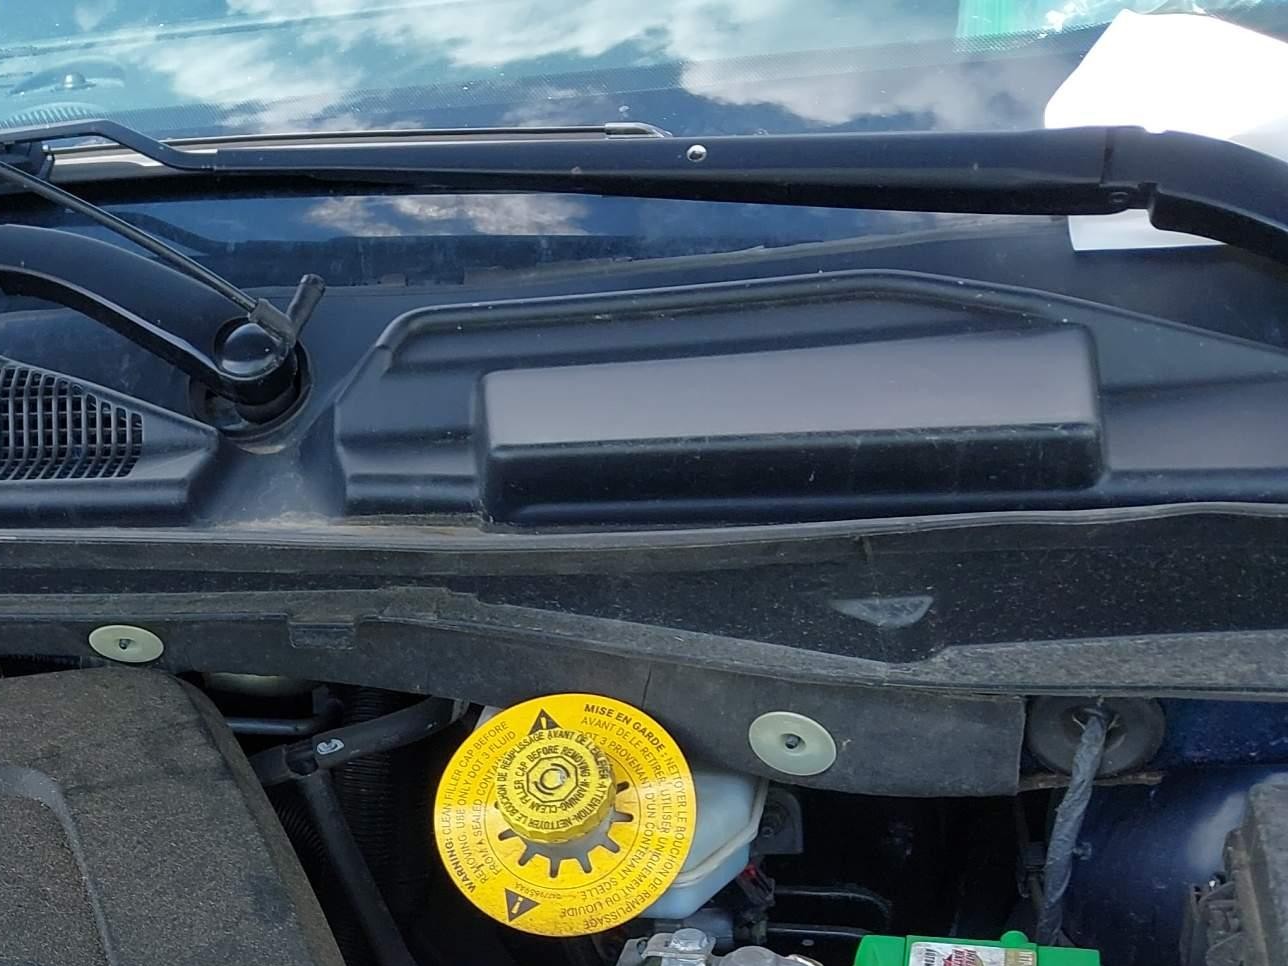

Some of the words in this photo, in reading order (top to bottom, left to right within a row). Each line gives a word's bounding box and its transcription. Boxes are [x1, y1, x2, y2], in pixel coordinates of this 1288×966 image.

[584, 703, 614, 718] MISE
[615, 712, 632, 726] EN
[472, 720, 508, 750] BEFORE
[547, 731, 575, 740] AVANT
[581, 715, 615, 732] AVANT
[615, 727, 629, 739] DE
[629, 736, 642, 748] LE
[631, 721, 665, 752] GARDE
[458, 748, 476, 768] CAP
[500, 732, 544, 770] REMPLISSAGE
[527, 745, 559, 762] BEFORE
[606, 740, 652, 788] PROVENANT
[457, 779, 472, 805] ONLY
[466, 758, 483, 778] DOT
[481, 751, 490, 759] 3
[487, 730, 516, 753] FLUID
[498, 772, 507, 781] DE
[515, 761, 528, 776] CAP
[445, 768, 463, 800] FILLER
[514, 780, 531, 804] FILLER
[442, 803, 452, 834] CLEAN
[471, 798, 483, 836] SEALED
[677, 811, 686, 821] LE
[443, 837, 478, 892] WARNING:
[657, 826, 685, 877] BOUCHON
[648, 877, 664, 891] DE
[583, 889, 652, 928] REMPLISSAGE
